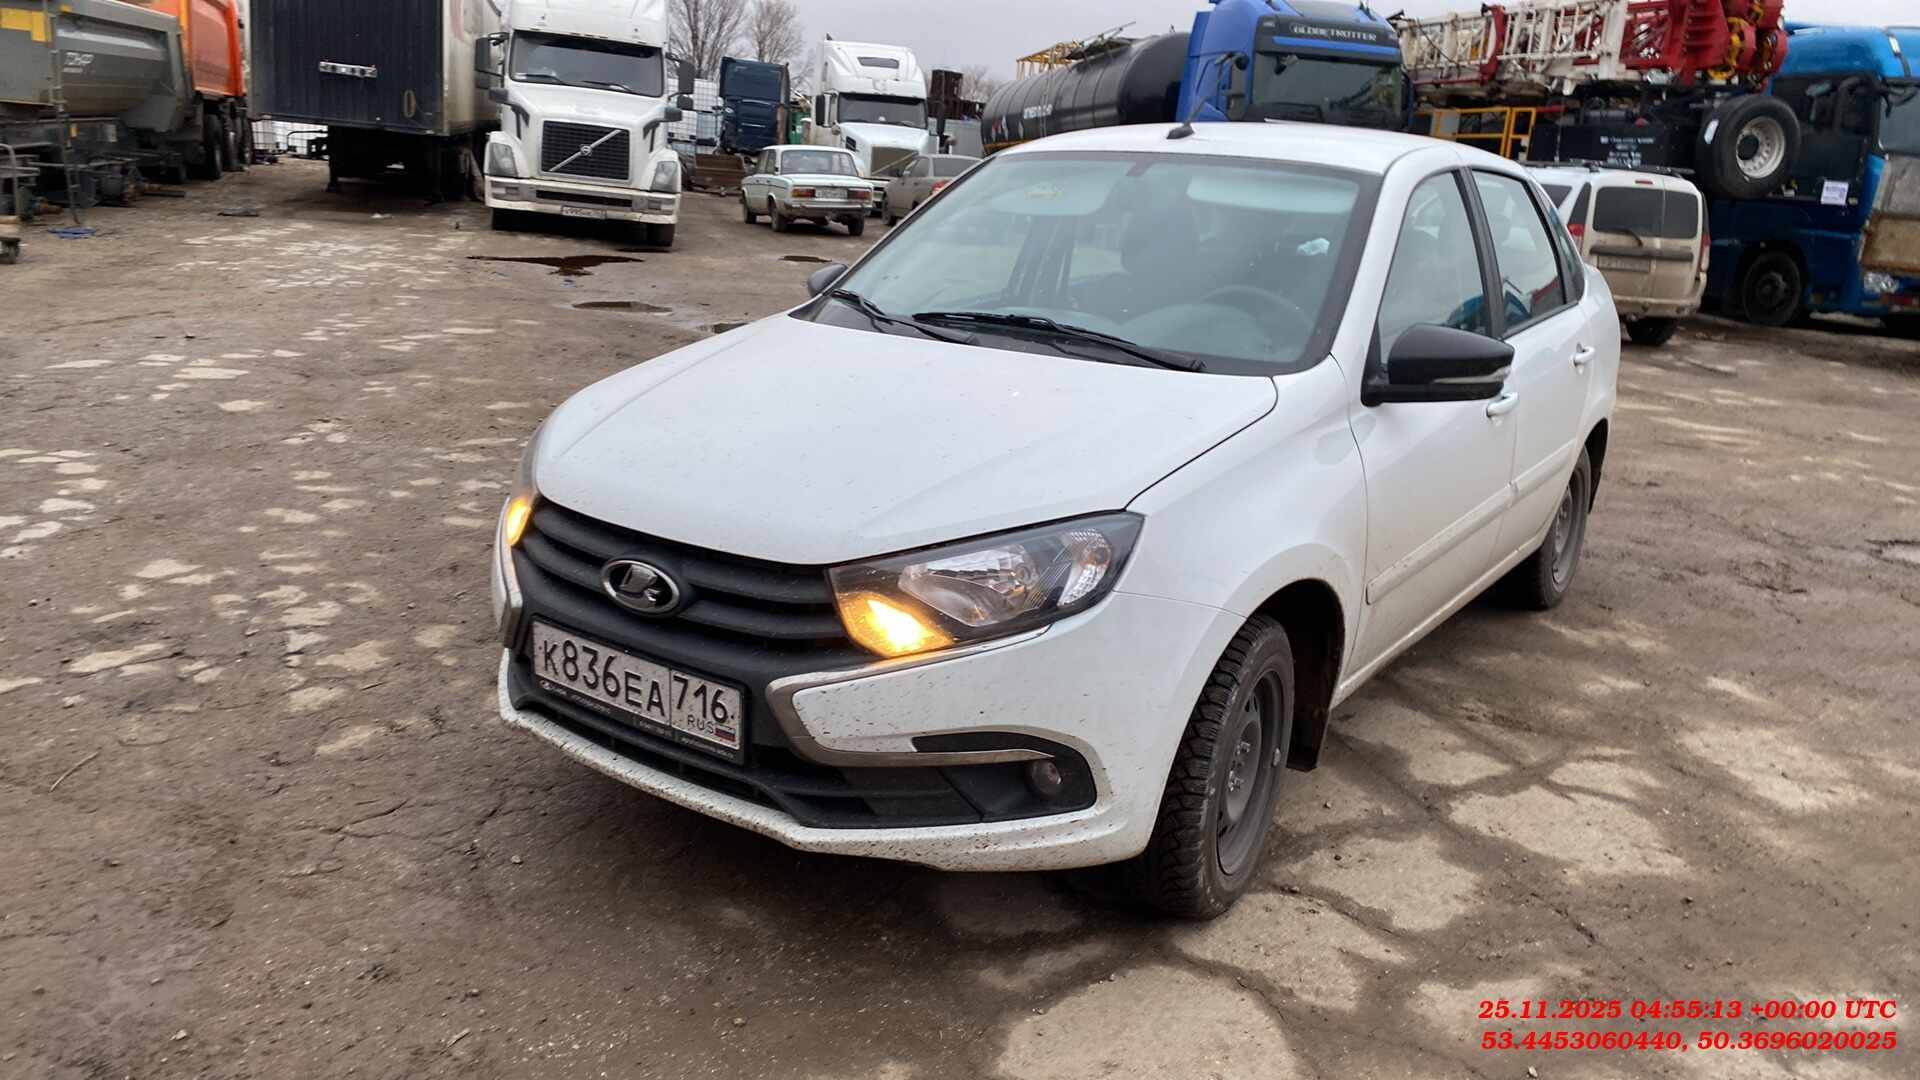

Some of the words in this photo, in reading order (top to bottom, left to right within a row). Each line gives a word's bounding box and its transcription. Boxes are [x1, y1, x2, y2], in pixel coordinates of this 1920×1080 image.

[543, 639, 666, 717] К836ЕА
[673, 674, 729, 724] 716
[686, 714, 715, 735] RUS
